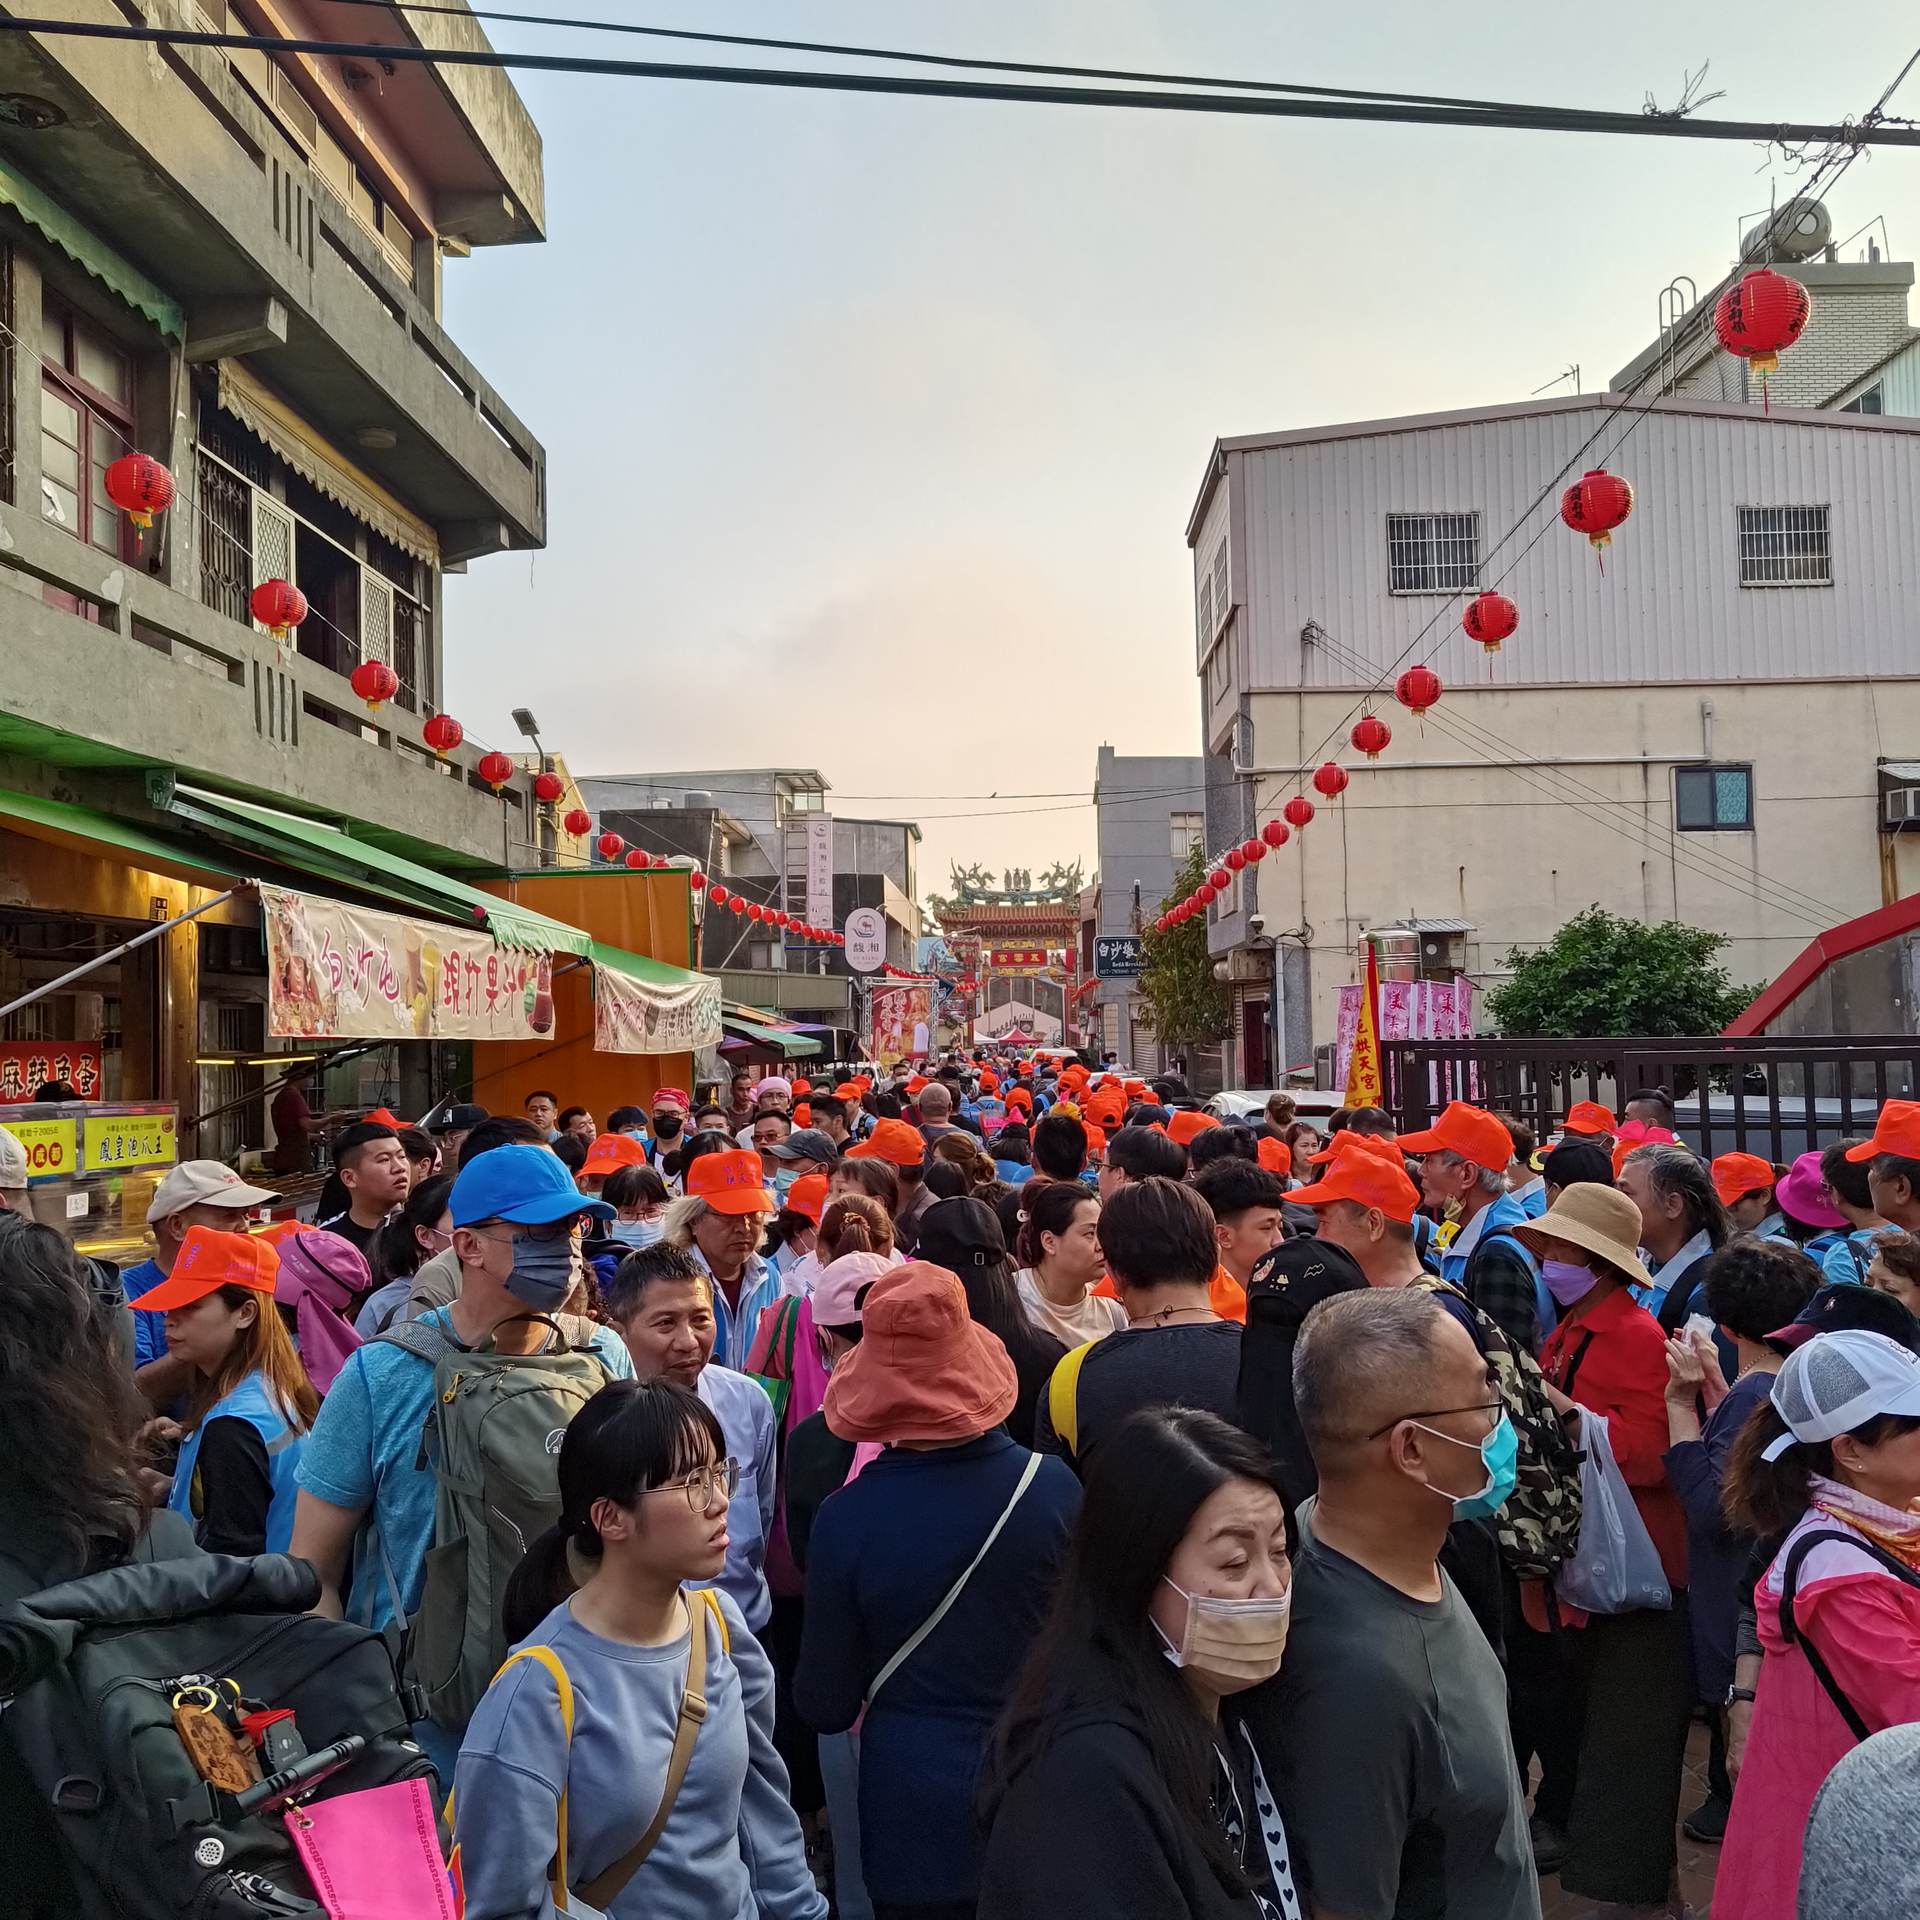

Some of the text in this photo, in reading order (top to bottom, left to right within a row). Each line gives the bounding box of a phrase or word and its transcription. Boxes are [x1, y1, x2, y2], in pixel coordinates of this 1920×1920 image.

[321, 927, 400, 1009] 白沙屯
[443, 950, 519, 1017] 現打果汁
